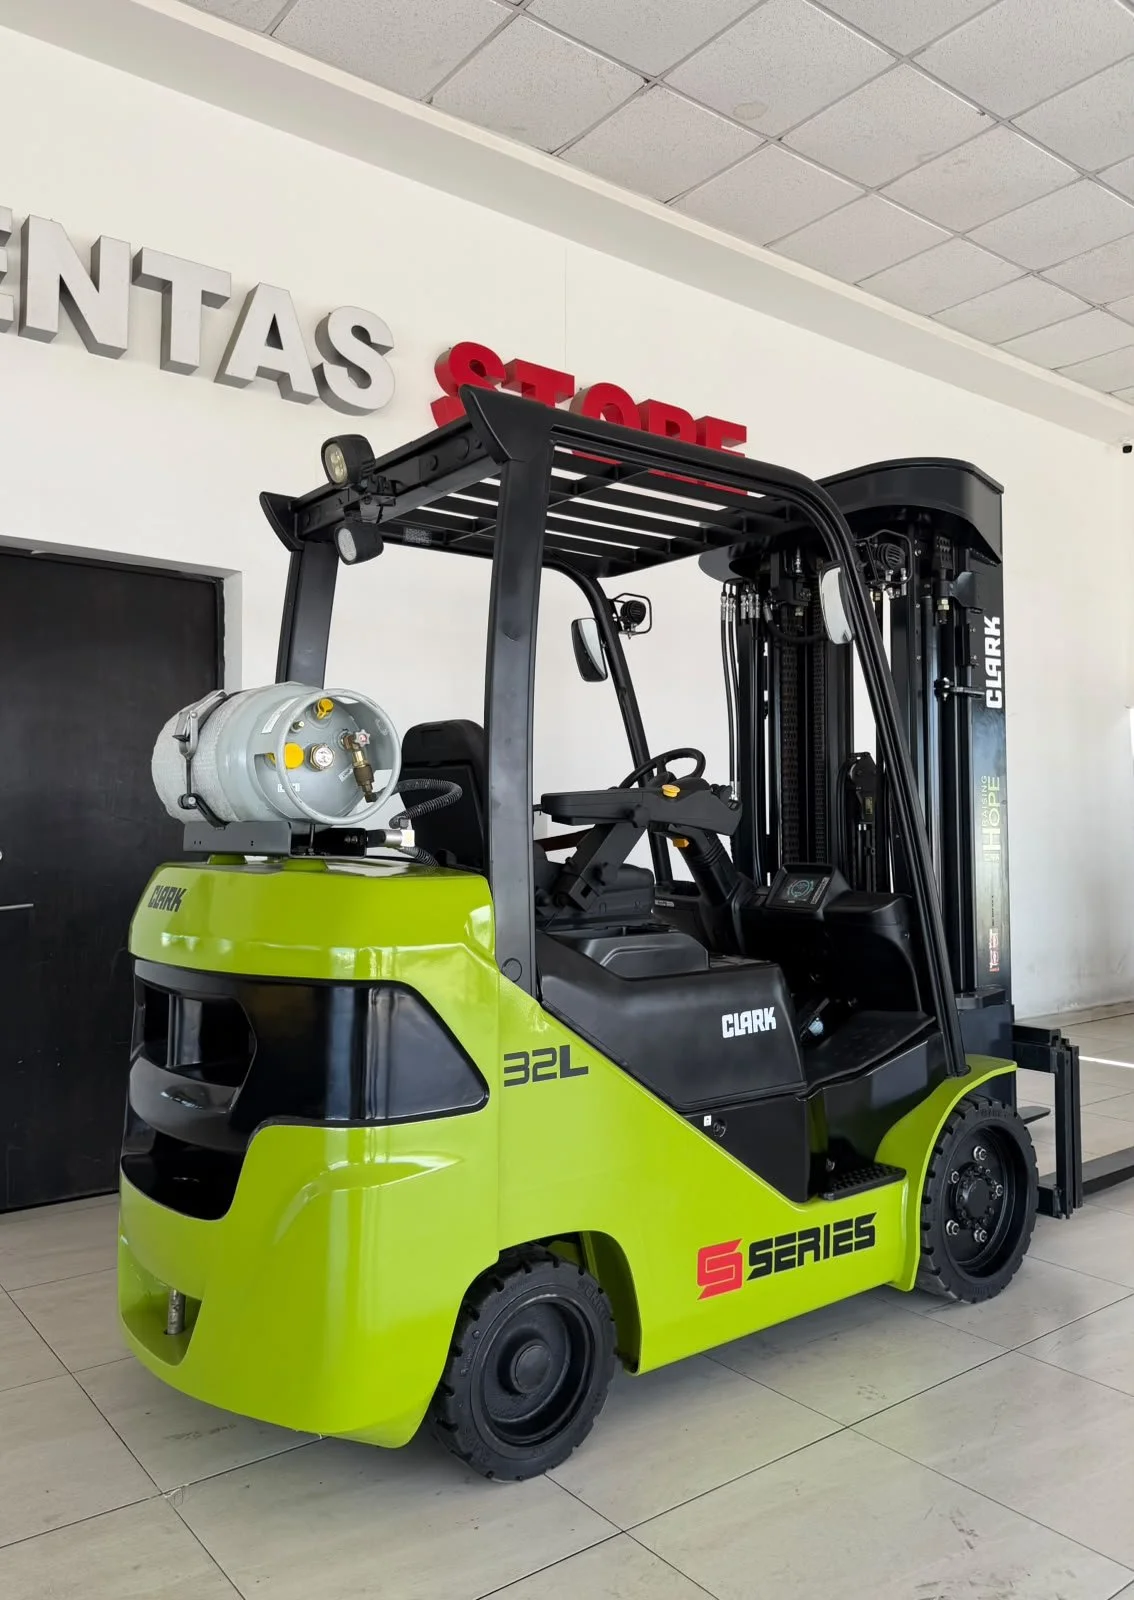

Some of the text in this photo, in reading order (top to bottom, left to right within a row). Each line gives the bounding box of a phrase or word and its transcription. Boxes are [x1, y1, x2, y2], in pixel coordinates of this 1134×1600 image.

[0, 205, 396, 416] NTAS
[984, 616, 1002, 709] CLARK
[147, 885, 188, 912] CLARK
[722, 1007, 777, 1039] CLARK
[503, 1044, 589, 1088] 32L
[746, 1212, 877, 1282] SERIES
